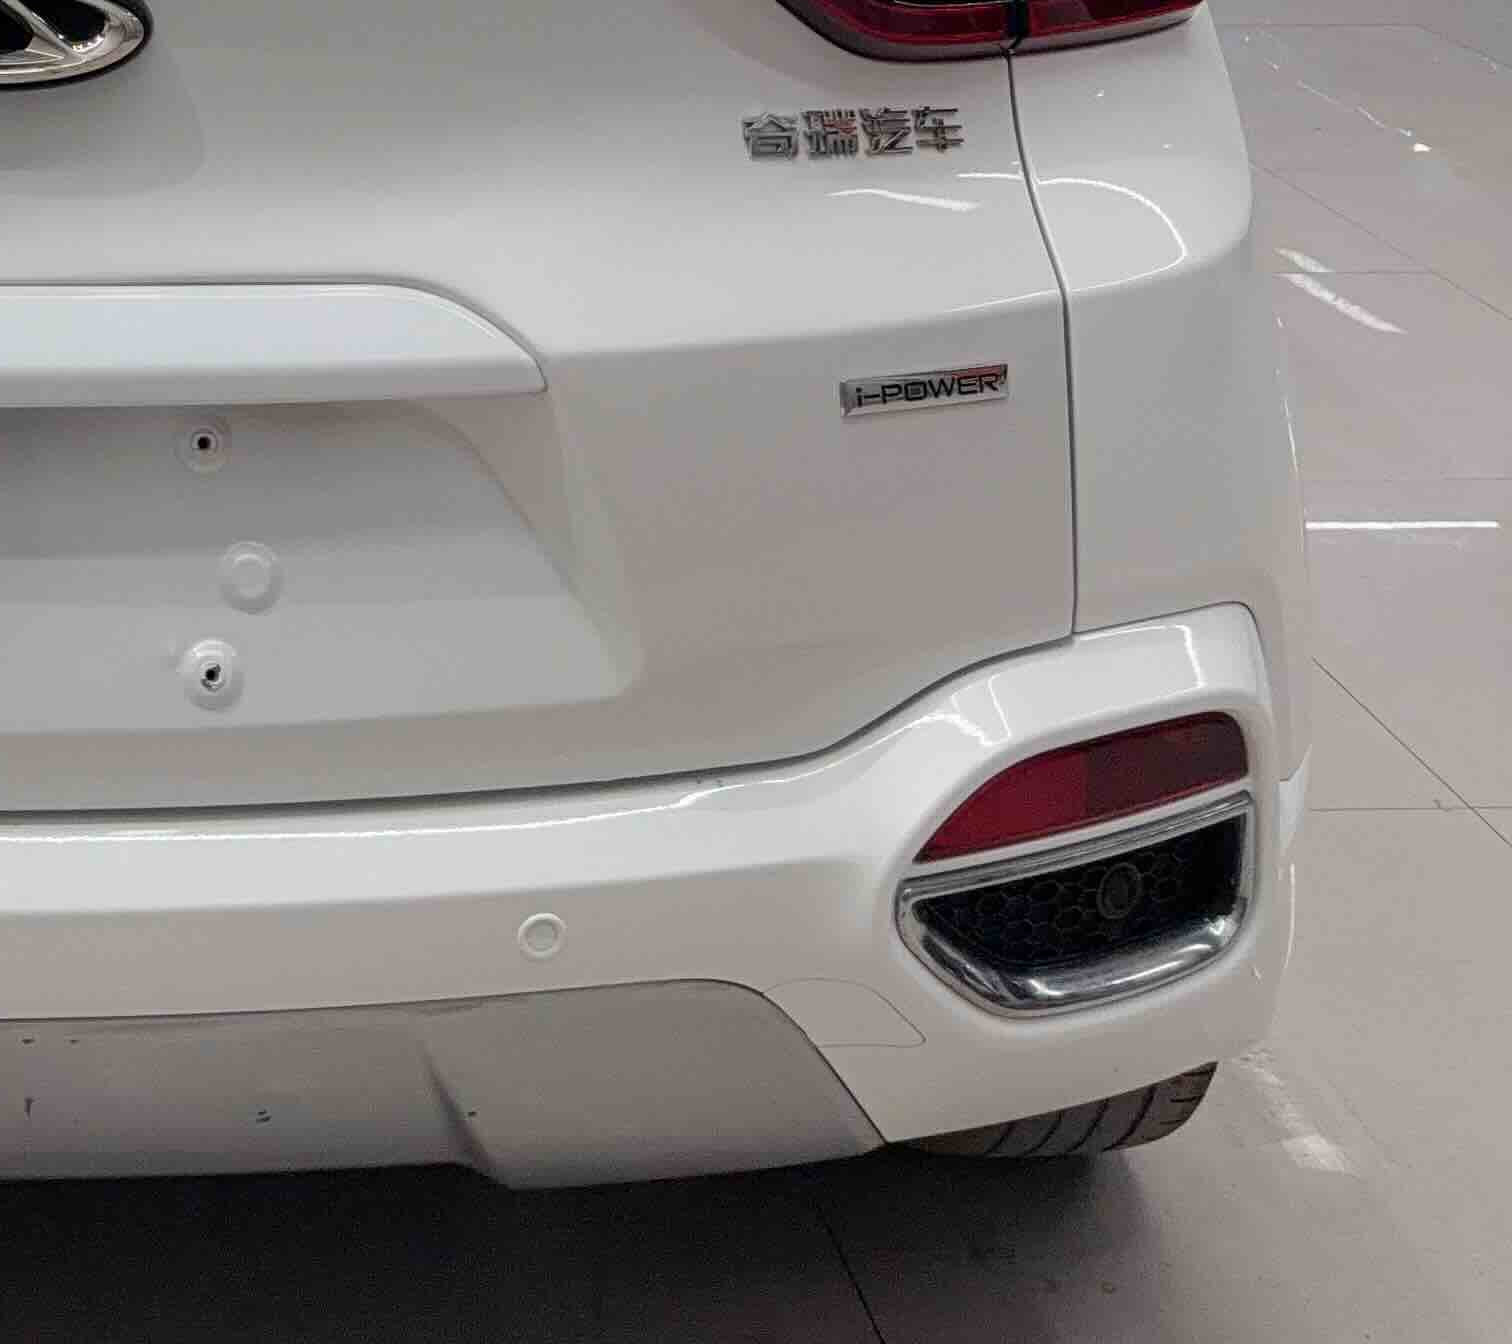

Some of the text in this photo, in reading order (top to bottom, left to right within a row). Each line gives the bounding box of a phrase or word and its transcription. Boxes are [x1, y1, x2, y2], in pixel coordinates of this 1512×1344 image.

[742, 107, 965, 162] 奇瑞汽车
[855, 372, 1000, 408] i-POWER
